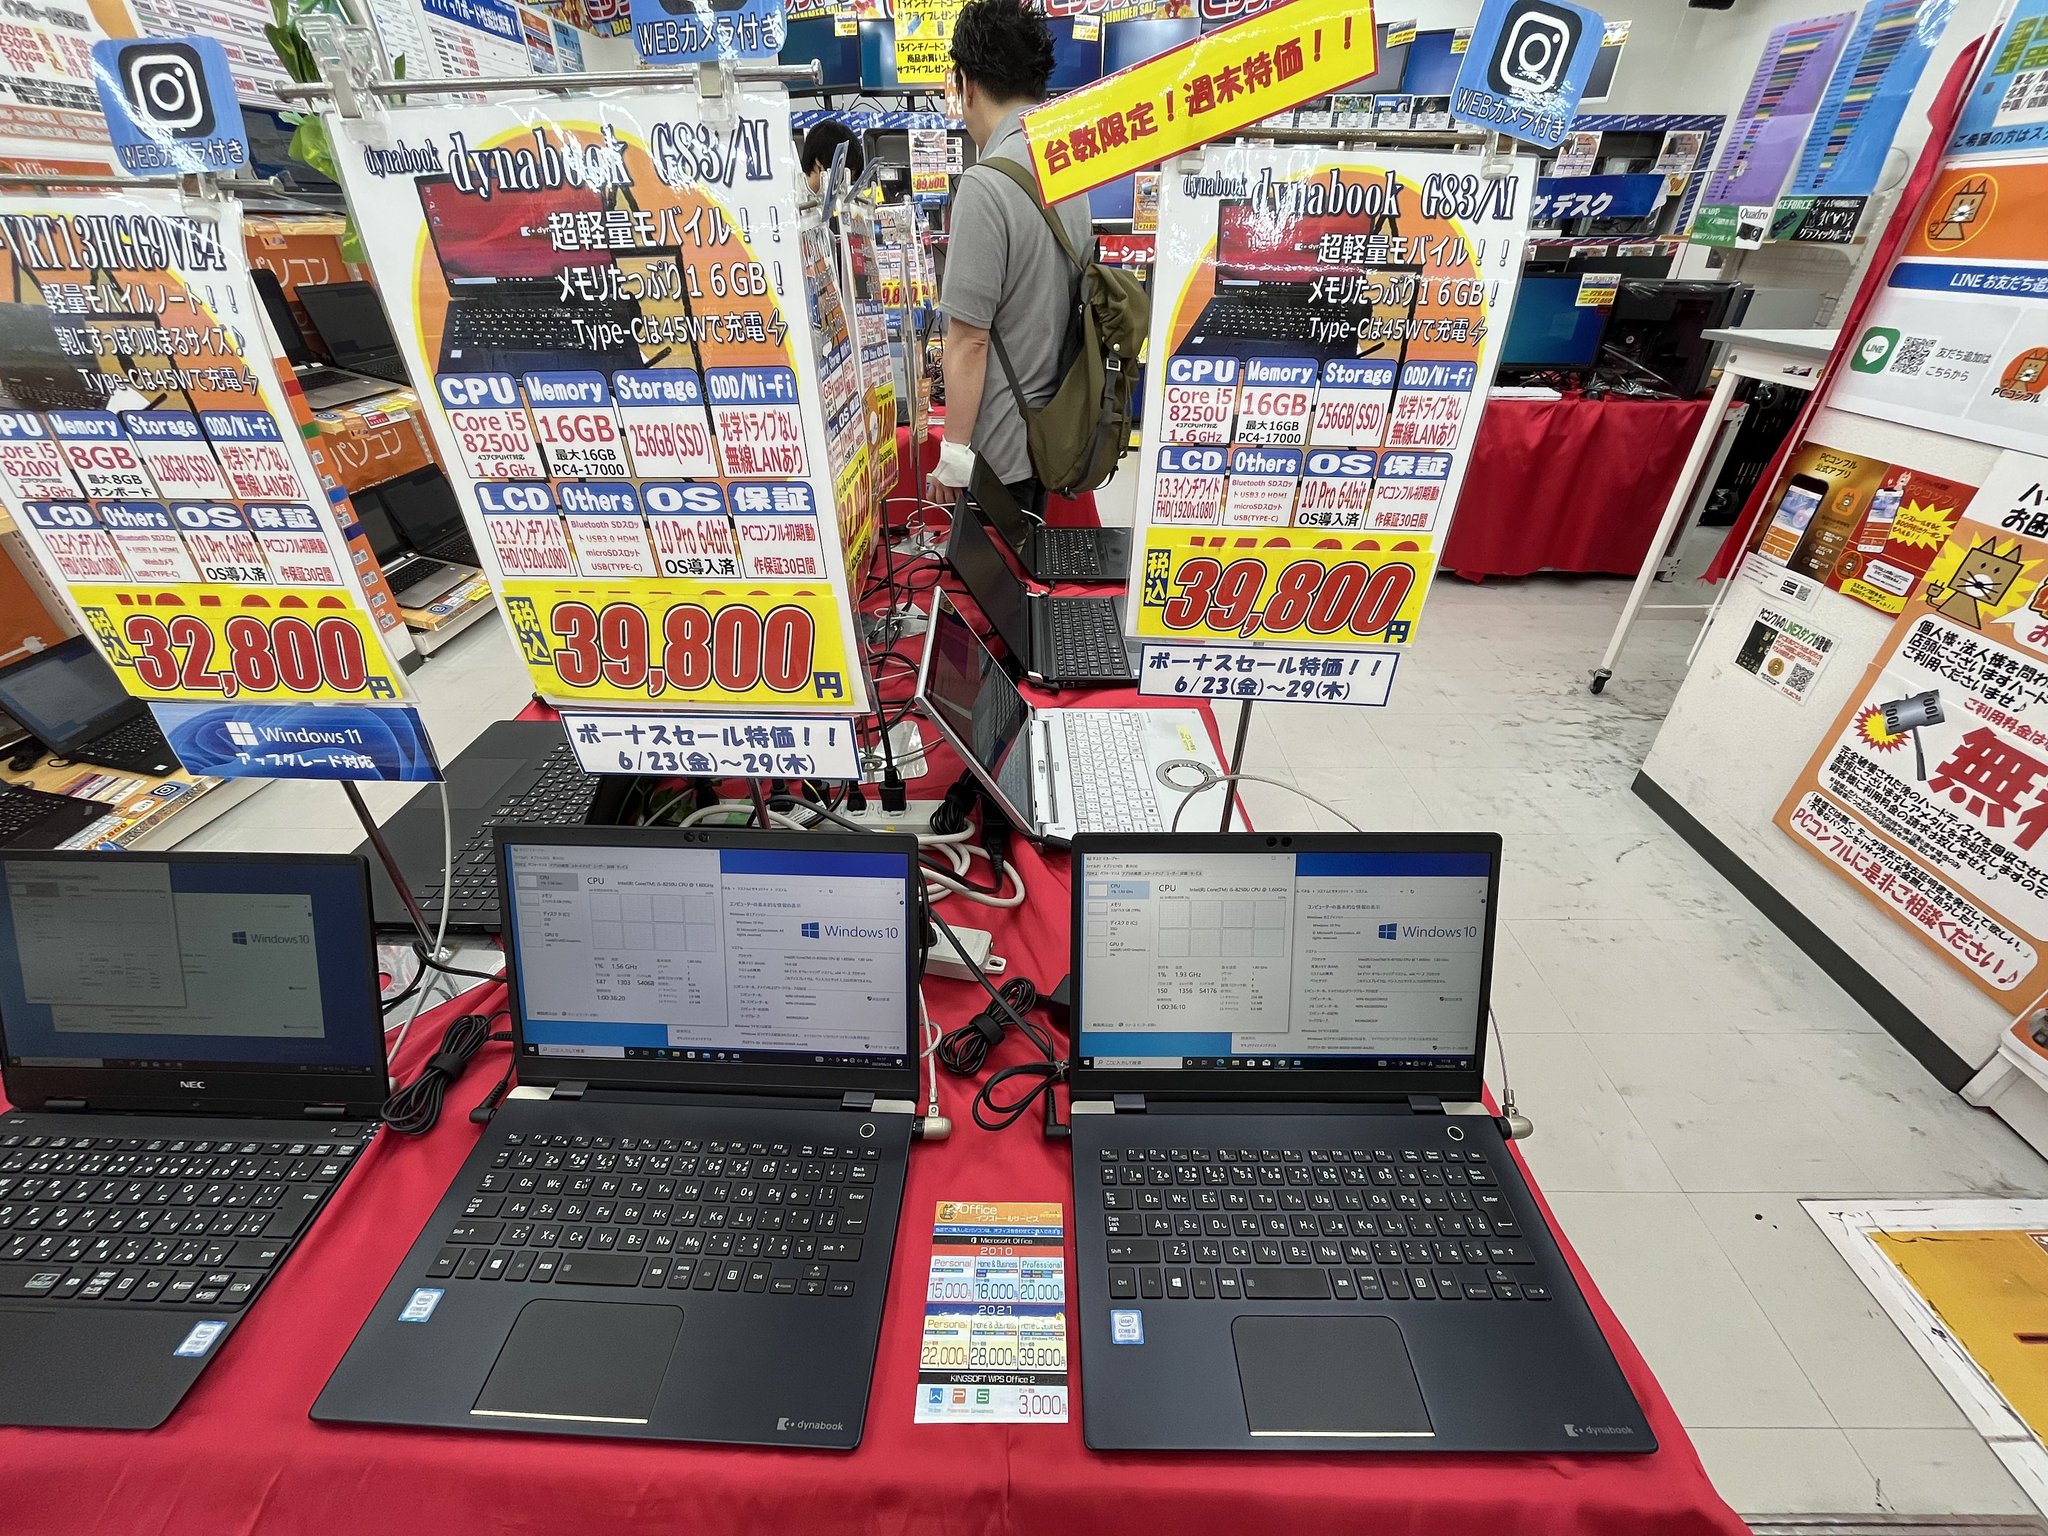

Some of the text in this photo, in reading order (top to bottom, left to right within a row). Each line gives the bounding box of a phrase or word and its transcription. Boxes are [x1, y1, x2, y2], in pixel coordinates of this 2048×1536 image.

[639, 15, 780, 56] WEBカメラ付き
[1043, 17, 1353, 176] 台数限定！週末特価！！
[1455, 87, 1565, 143] WEBカメラ付き
[120, 139, 244, 171] WEBカメラ付き
[363, 139, 443, 177] dynabook
[447, 125, 633, 199] dynabook
[1183, 171, 1247, 199] dynabook
[1251, 168, 1404, 219] dynabook
[547, 206, 782, 252] 超軽量モバイル！！
[1317, 234, 1509, 267] 超軽量モバイル！！
[1950, 273, 1982, 288] LINE
[41, 283, 239, 314] 軽量モバイルノート！！
[571, 314, 766, 350] Type-Cは45Wで充電
[1308, 317, 1468, 344] Type-Cは45Wで充電
[1935, 348, 1992, 364] 友だち追加は
[1171, 359, 1473, 388] CPU Memory Storage ODD/Wi-Fi
[1925, 366, 1970, 381] こちらから
[441, 373, 794, 405] CPU Memory Storage ODD/Wi-Fi
[1168, 388, 1233, 406] Core i5
[1991, 388, 2041, 403] PCコンフル
[1169, 405, 1227, 423] 8250U
[1242, 393, 1307, 417] 16GB
[1398, 396, 1461, 421] 光学ドライブなし
[48, 414, 277, 438] Memory Storage ODD/Wi-Fi
[453, 412, 527, 432] Core i5
[540, 415, 615, 444] 16GB
[720, 411, 798, 443] 光学ドライブなし
[1246, 420, 1300, 432] 最大16GB
[1317, 402, 1385, 437] 256GB(SSD)
[465, 433, 530, 453] 8250U
[630, 423, 712, 465] 256GB(SSD)
[1169, 429, 1223, 443] 1.6GHz
[1238, 432, 1301, 444] PC4-17000
[1390, 421, 1458, 446] 無線LANあり
[69, 446, 137, 470] 8GB
[221, 447, 289, 471] 光学ドライブなし
[328, 427, 402, 473] パソコン
[555, 449, 617, 462] 最大16GB
[725, 443, 804, 476] 無線LANあり
[4, 460, 62, 477] 8200Y
[149, 454, 225, 489] 128GB(SSD)
[476, 462, 538, 478] 1.6GHz
[553, 463, 625, 476] PC4-17000
[1161, 450, 1372, 475] LCD Others OS
[1384, 455, 1447, 477] 保証
[91, 487, 152, 498] オンボード
[233, 474, 302, 499] 無線LANあり
[1158, 477, 1220, 499] 13.3インチワイド
[1232, 479, 1266, 488] Bluetooth
[1376, 486, 1440, 501] PCコンフル初期動
[482, 487, 720, 512] LCD Others OS
[734, 487, 810, 513] 保証
[1301, 481, 1367, 511] 10 Pro 64bit
[30, 506, 243, 528] LCD Others OS
[252, 508, 318, 529] 保証
[1156, 500, 1217, 523] FHD(1920x1080)
[1233, 514, 1278, 523] USB(TYPE-C)
[1299, 512, 1359, 527] OS導入済
[1374, 514, 1427, 528] 作保証30日間
[490, 519, 562, 546] 13.3インチワイド
[571, 520, 609, 529] Bluetooth
[741, 524, 815, 542] PCコンフル初期動
[655, 520, 733, 554] 10 Pro 64bit
[500, 546, 574, 571] FHD(1920x1080)
[586, 549, 641, 558] microSDスロット
[207, 566, 267, 582] OS導入済
[591, 562, 643, 573] USB(TYPE-C)
[665, 559, 736, 576] OS導入済
[753, 556, 817, 576] 作保証30日間
[1144, 551, 1170, 606] 税込
[1162, 557, 1415, 643] 39,800 円
[85, 608, 132, 666] 税込
[508, 599, 553, 665] 税込
[125, 614, 395, 699] 32,800 円
[551, 602, 843, 698] 39,800 円
[1150, 652, 1382, 677] ボーナスセール特価！！
[1174, 676, 1351, 699] 6/23(金)～29(木)
[1902, 646, 2015, 709] ご利用くださいませ
[258, 727, 362, 745] Windows 11
[577, 724, 836, 748] ボーナスセール特価！！
[236, 752, 374, 769] アップグレード対応
[618, 751, 816, 774] 6/23(金)～29(木)
[1792, 808, 2004, 974] PCコンフルに是非ご相談ください
[825, 925, 898, 939] Windows 10
[1402, 925, 1477, 938] Windows 10
[960, 1204, 997, 1214] Office
[980, 1247, 1013, 1256] 2010
[935, 1259, 1062, 1269] Personal Professional
[930, 1283, 1060, 1302] 15,000 18,000 20,000
[978, 1306, 1013, 1315] 2021
[921, 1346, 1061, 1368] 22,000 28,000 39,800
[950, 1375, 986, 1383] KINGSOFT
[1019, 1395, 1062, 1415] 3,000
[797, 1419, 843, 1432] dynabook
[1585, 1425, 1634, 1437] dynabook
